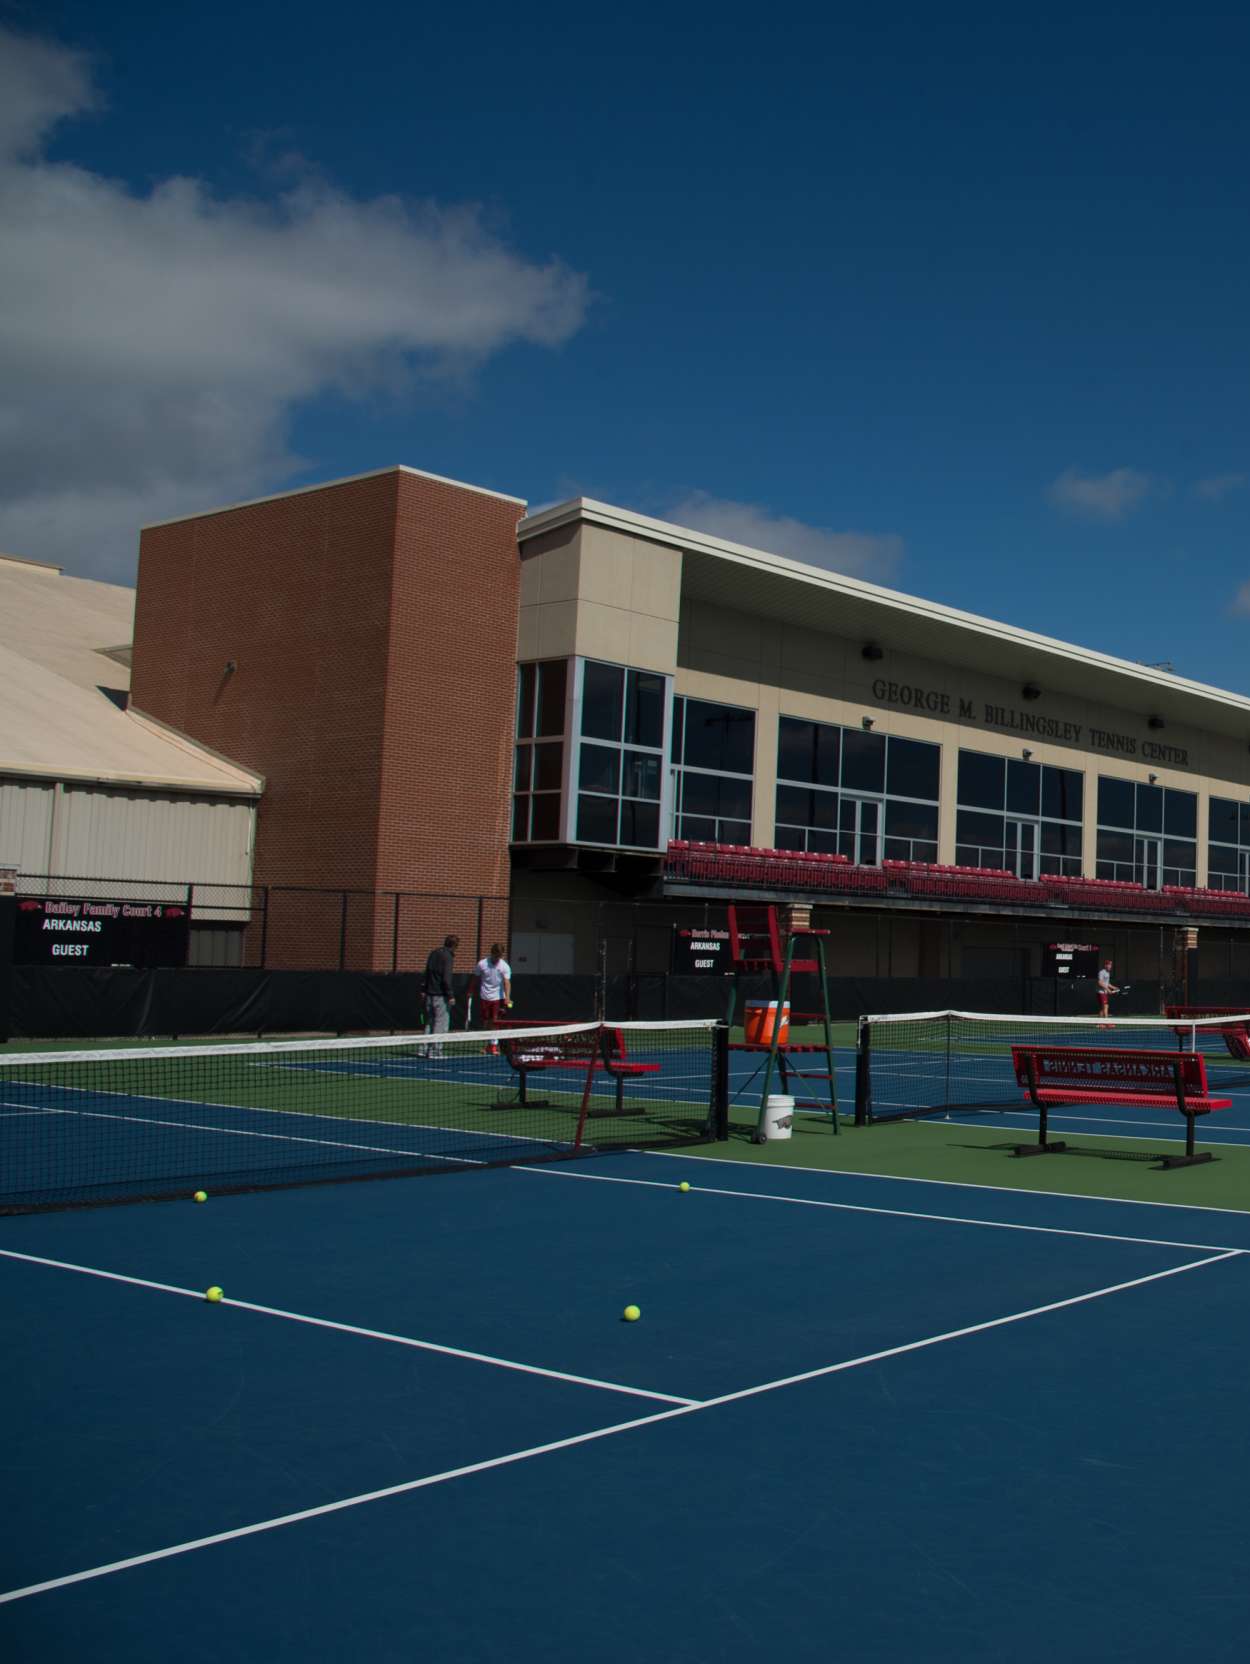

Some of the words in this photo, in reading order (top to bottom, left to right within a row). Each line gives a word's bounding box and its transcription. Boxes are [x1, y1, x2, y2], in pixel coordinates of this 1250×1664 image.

[872, 679, 950, 713] GEORGE
[959, 698, 976, 720] M.
[984, 704, 1082, 743] BILLINGSLEY
[1089, 728, 1137, 754] TENNIS
[1141, 741, 1189, 766] CENTER
[42, 919, 102, 932] ARKANSAS
[51, 944, 90, 956] GUEST
[694, 959, 714, 968] GUEST
